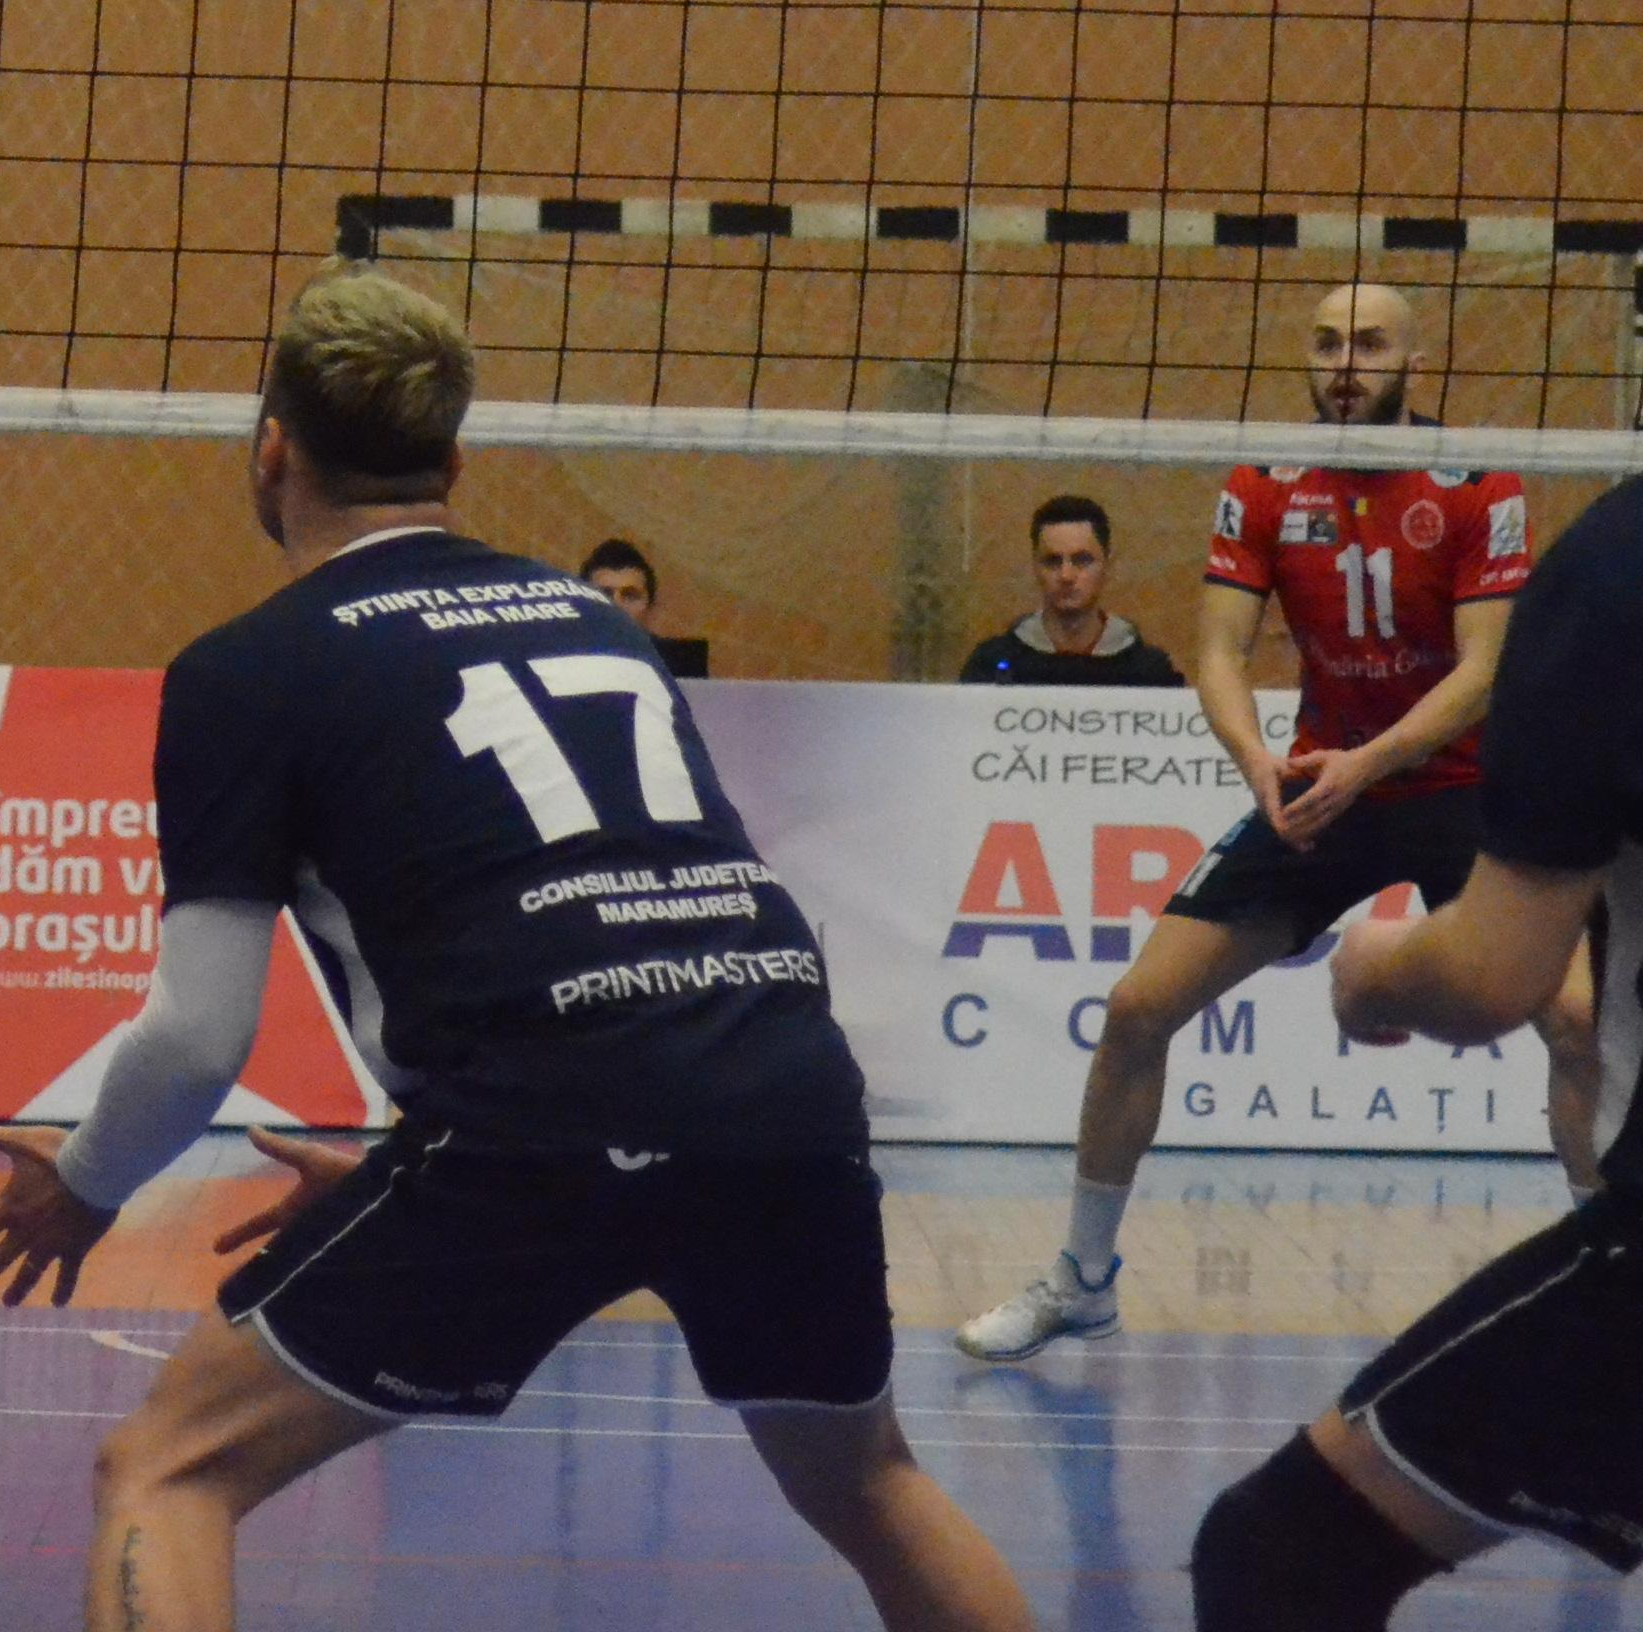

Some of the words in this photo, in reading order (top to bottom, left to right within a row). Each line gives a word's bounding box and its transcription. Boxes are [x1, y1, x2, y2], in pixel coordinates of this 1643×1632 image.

[331, 588, 459, 627] ȘTIINȚA
[1334, 542, 1397, 640] 11
[420, 605, 498, 630] BAIA
[493, 601, 581, 624] MARE
[993, 707, 1214, 738] CONSTRUC
[444, 654, 704, 845] 17
[971, 744, 1047, 783] CĂI
[519, 869, 666, 913] CONSILIUL
[595, 891, 758, 924] MARAMUREȘ
[550, 949, 821, 1015] PRINTMASTERS
[1184, 1082, 1497, 1134] GALAȚI
